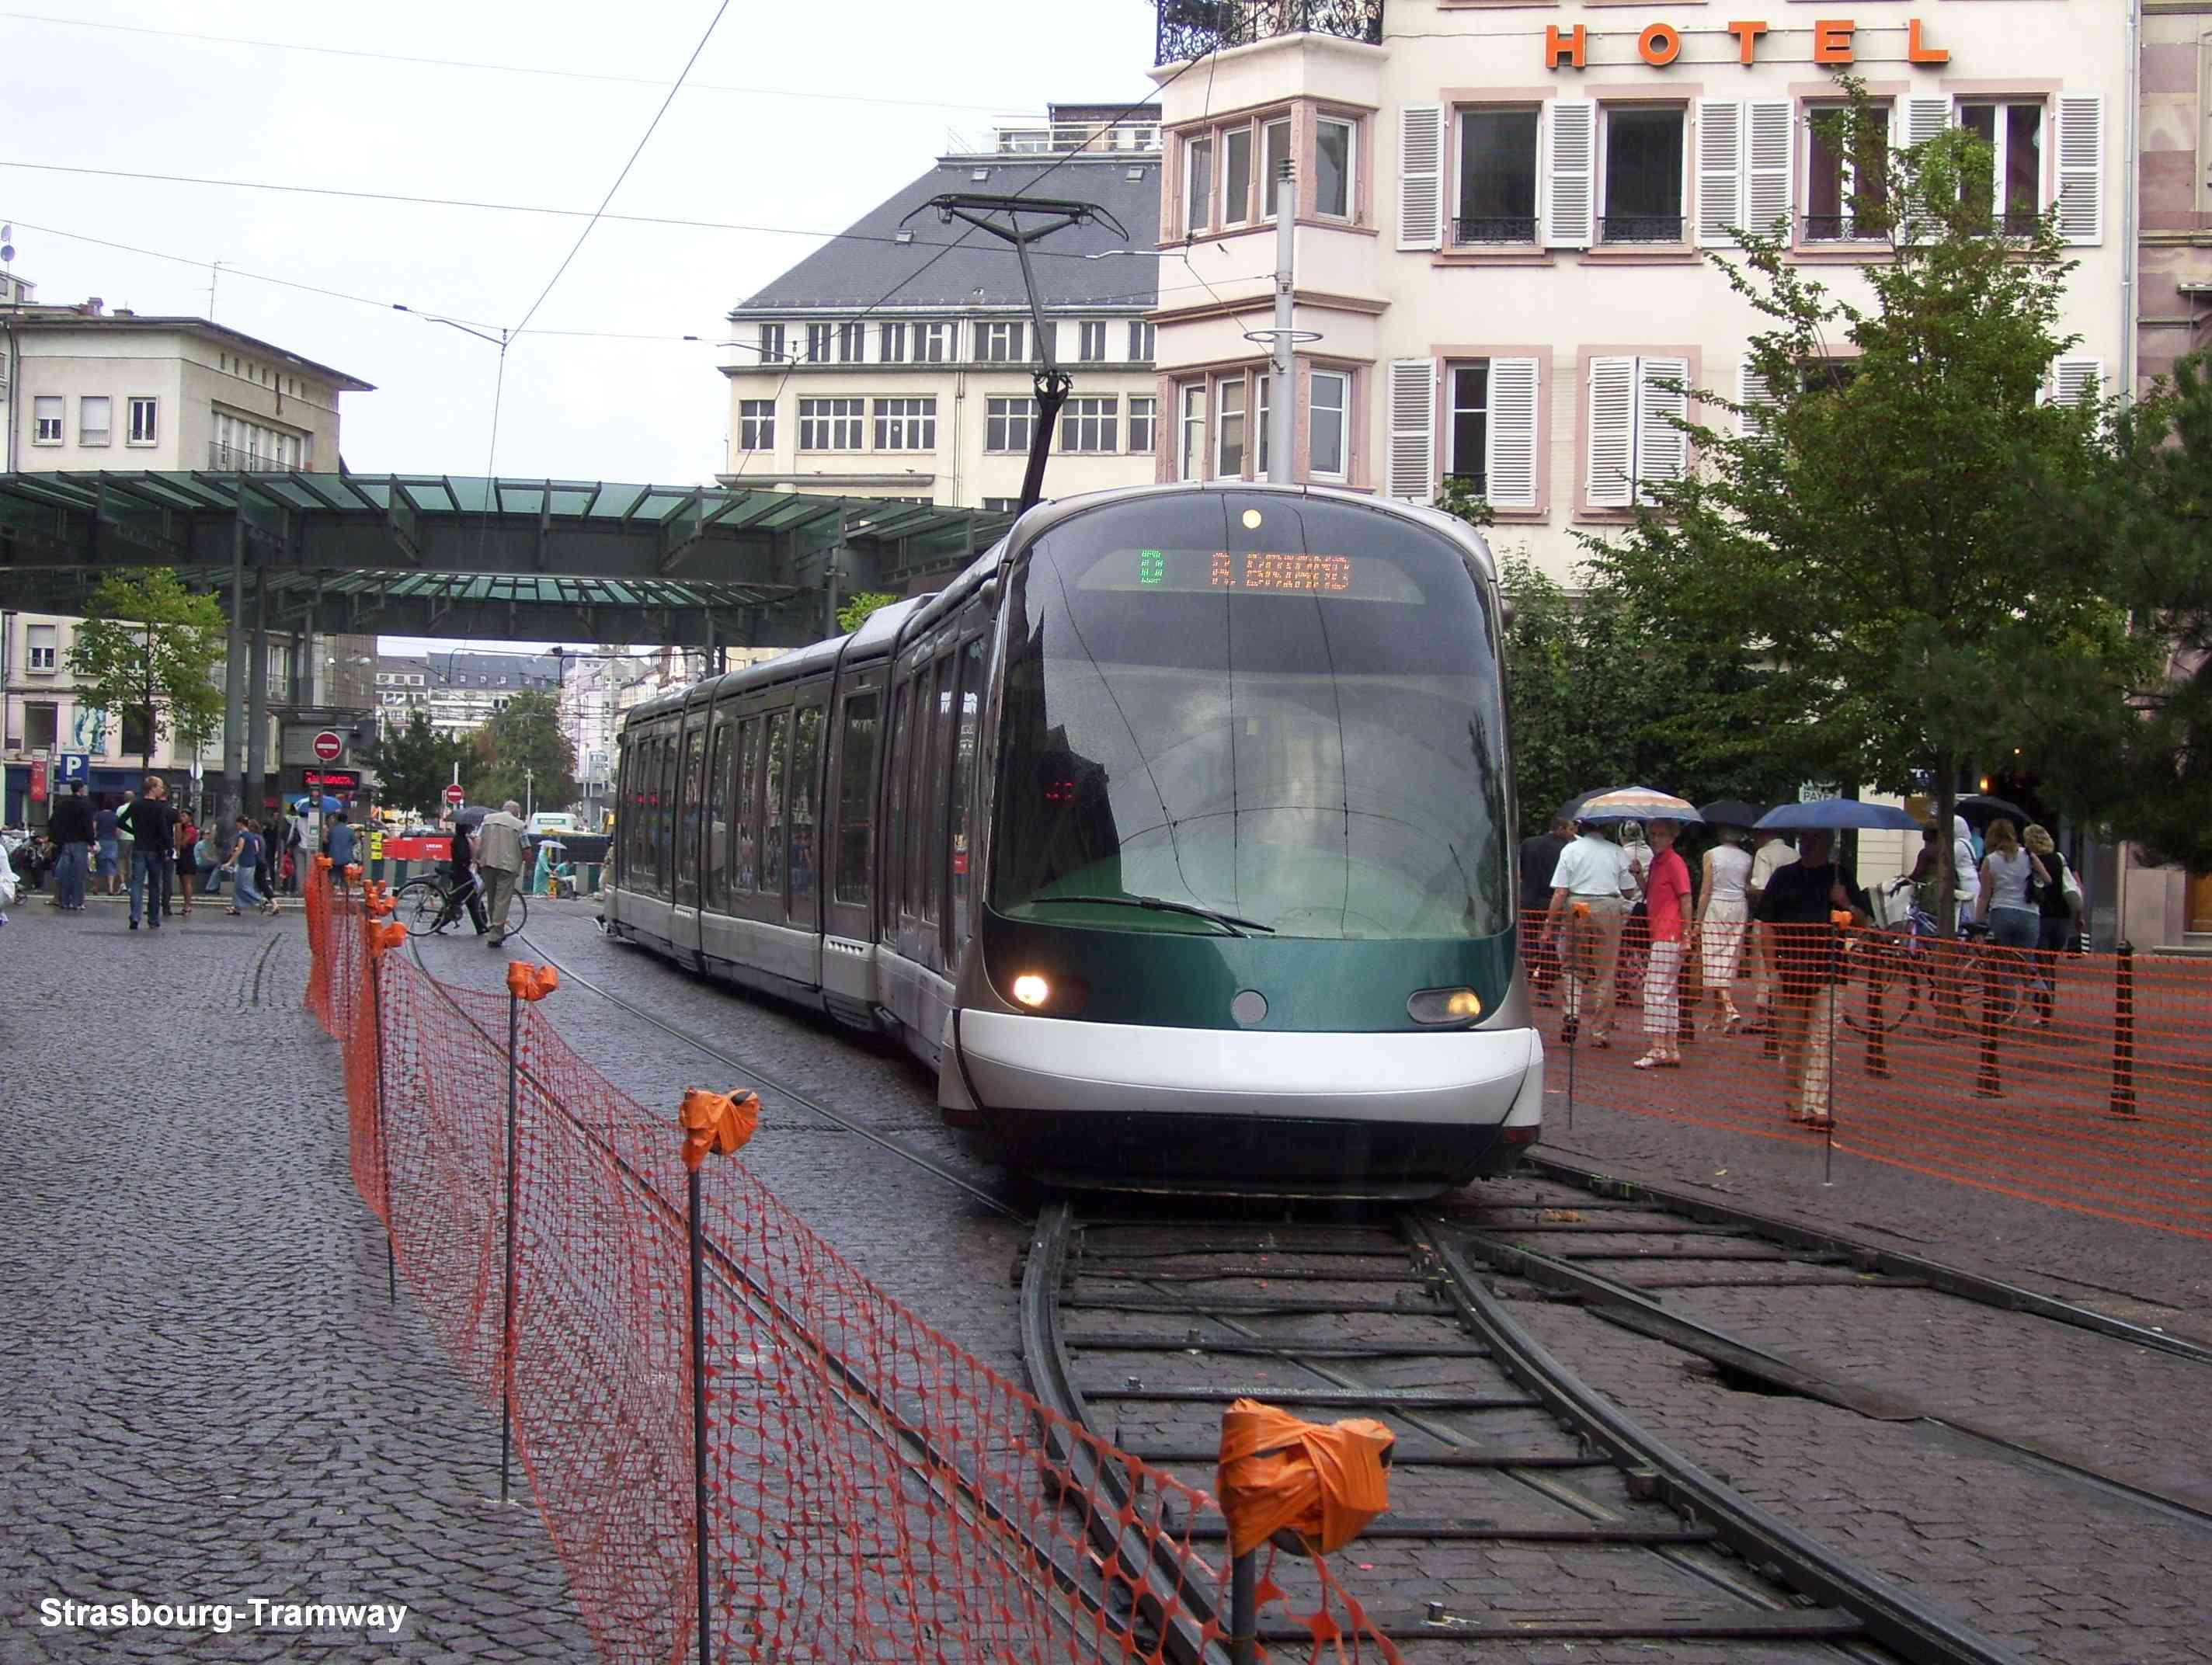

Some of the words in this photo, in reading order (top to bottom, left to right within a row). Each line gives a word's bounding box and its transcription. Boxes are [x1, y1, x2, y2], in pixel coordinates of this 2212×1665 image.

[1546, 19, 1950, 68] HOTEL
[1141, 549, 1163, 583] D
[66, 756, 82, 776] P
